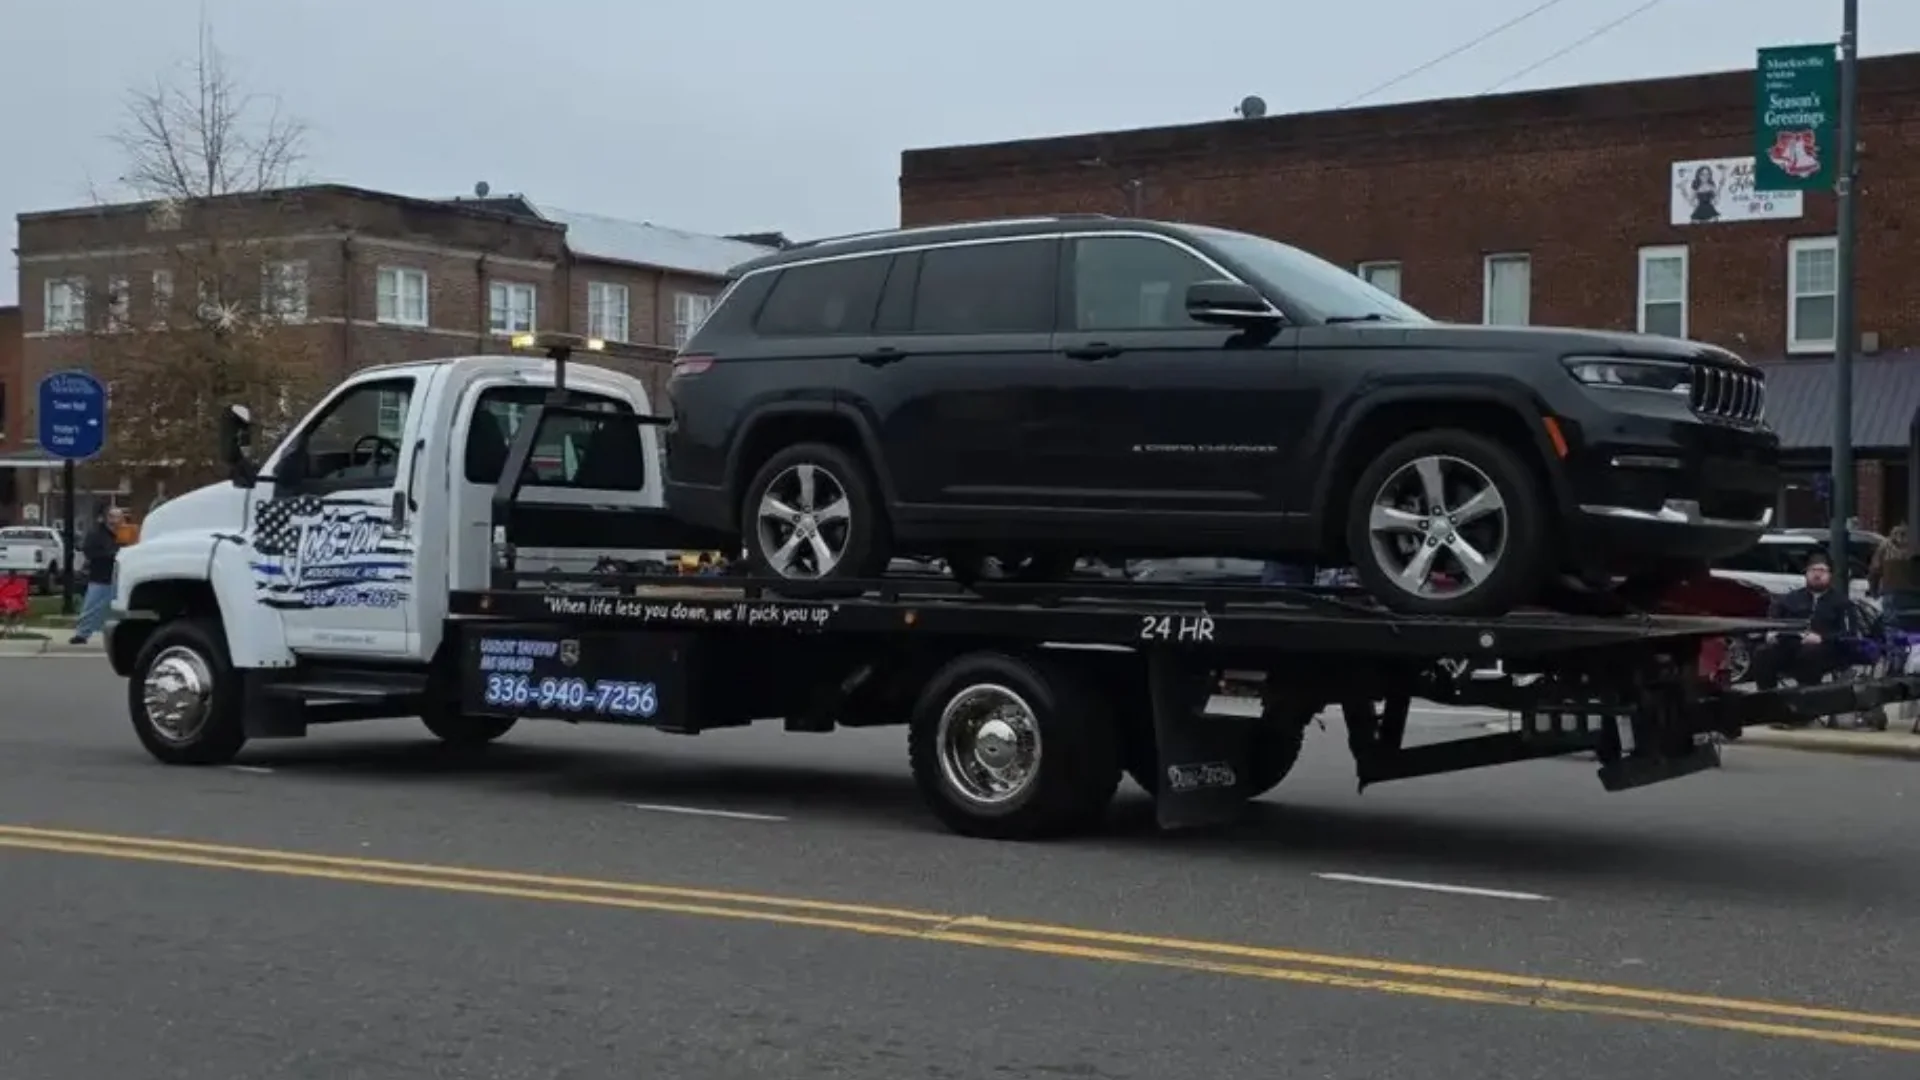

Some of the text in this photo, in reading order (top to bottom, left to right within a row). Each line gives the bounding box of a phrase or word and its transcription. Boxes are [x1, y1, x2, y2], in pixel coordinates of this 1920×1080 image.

[1769, 92, 1821, 109] Season's
[1764, 109, 1825, 129] Greetings
[590, 598, 612, 616] life
[616, 600, 641, 616] lets
[644, 604, 668, 621] you
[671, 602, 709, 622] down,
[713, 603, 746, 621] we'll
[749, 604, 779, 625] pick
[782, 606, 808, 625] you
[1141, 616, 1215, 641] 24 HR
[487, 675, 656, 714] 336-940-7256
